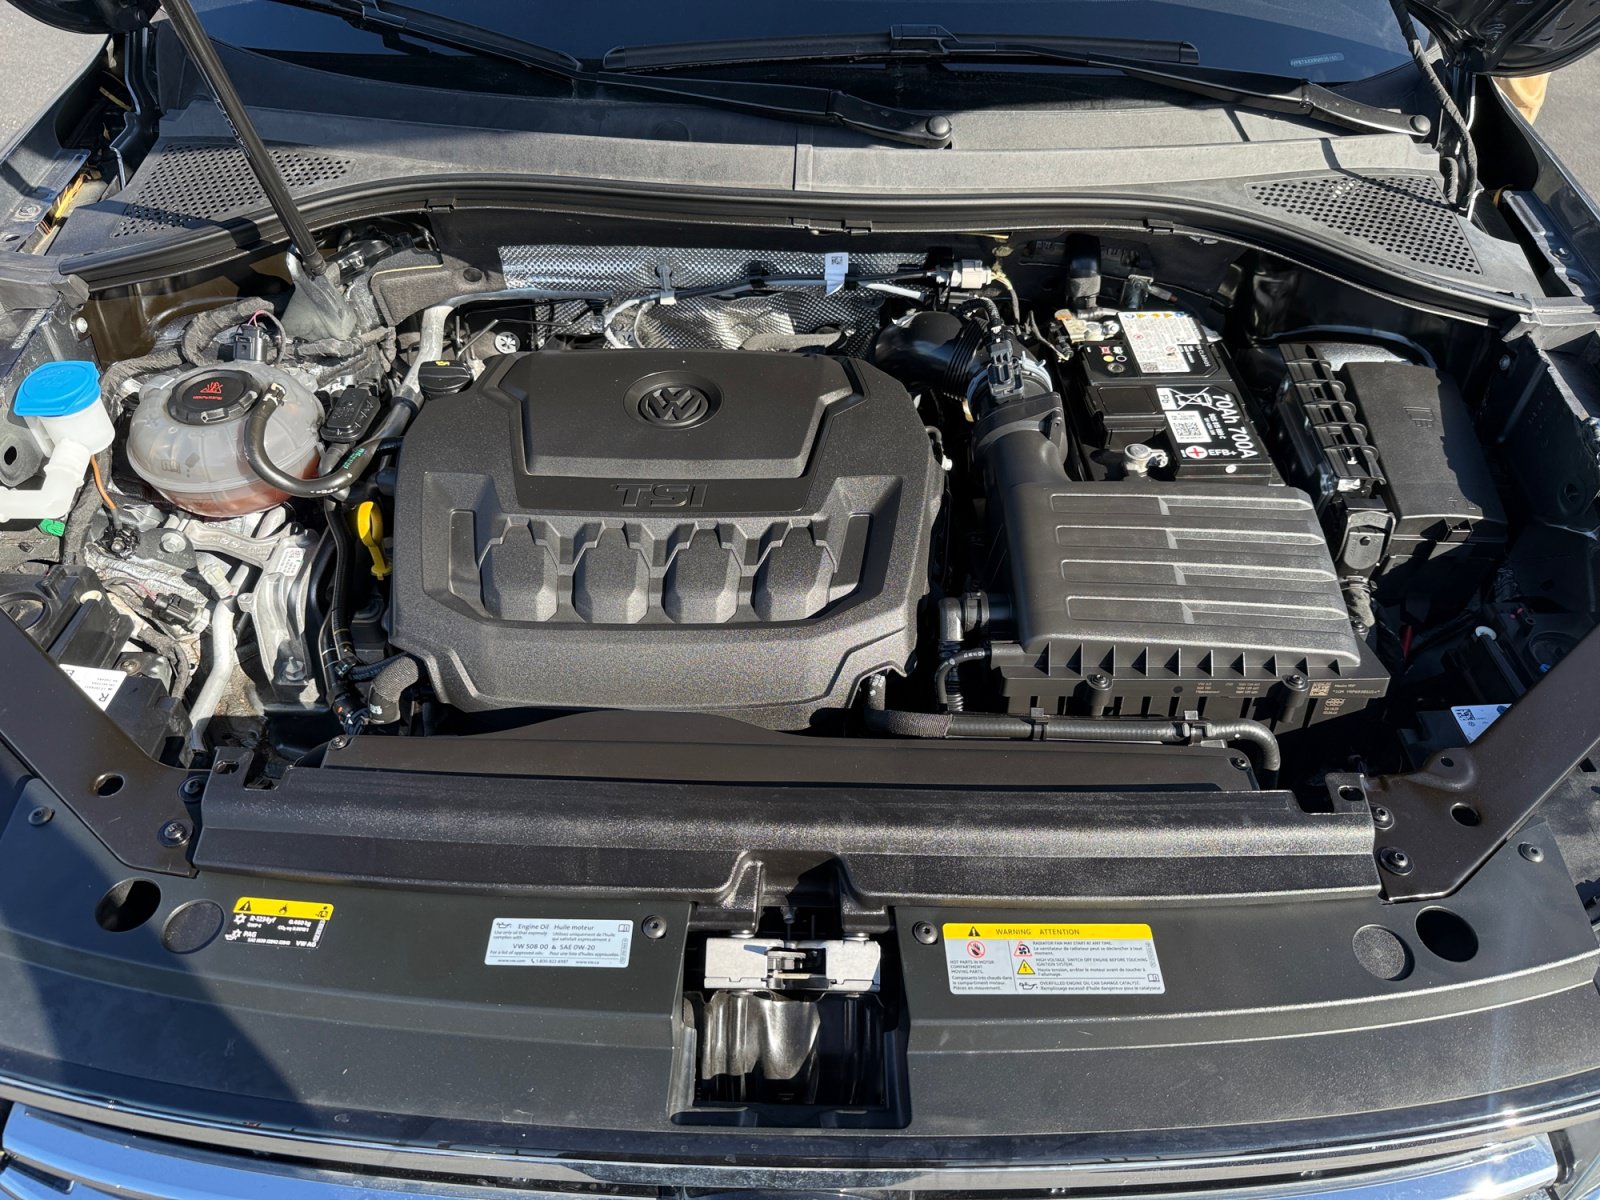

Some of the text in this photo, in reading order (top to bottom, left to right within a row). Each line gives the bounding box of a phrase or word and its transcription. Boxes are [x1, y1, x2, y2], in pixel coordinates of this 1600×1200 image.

[1212, 393, 1258, 459] 70Ah 700A
[615, 482, 708, 508] TSI
[99, 692, 109, 702] R
[249, 915, 277, 925] R-1234yf
[242, 930, 257, 938] PAG
